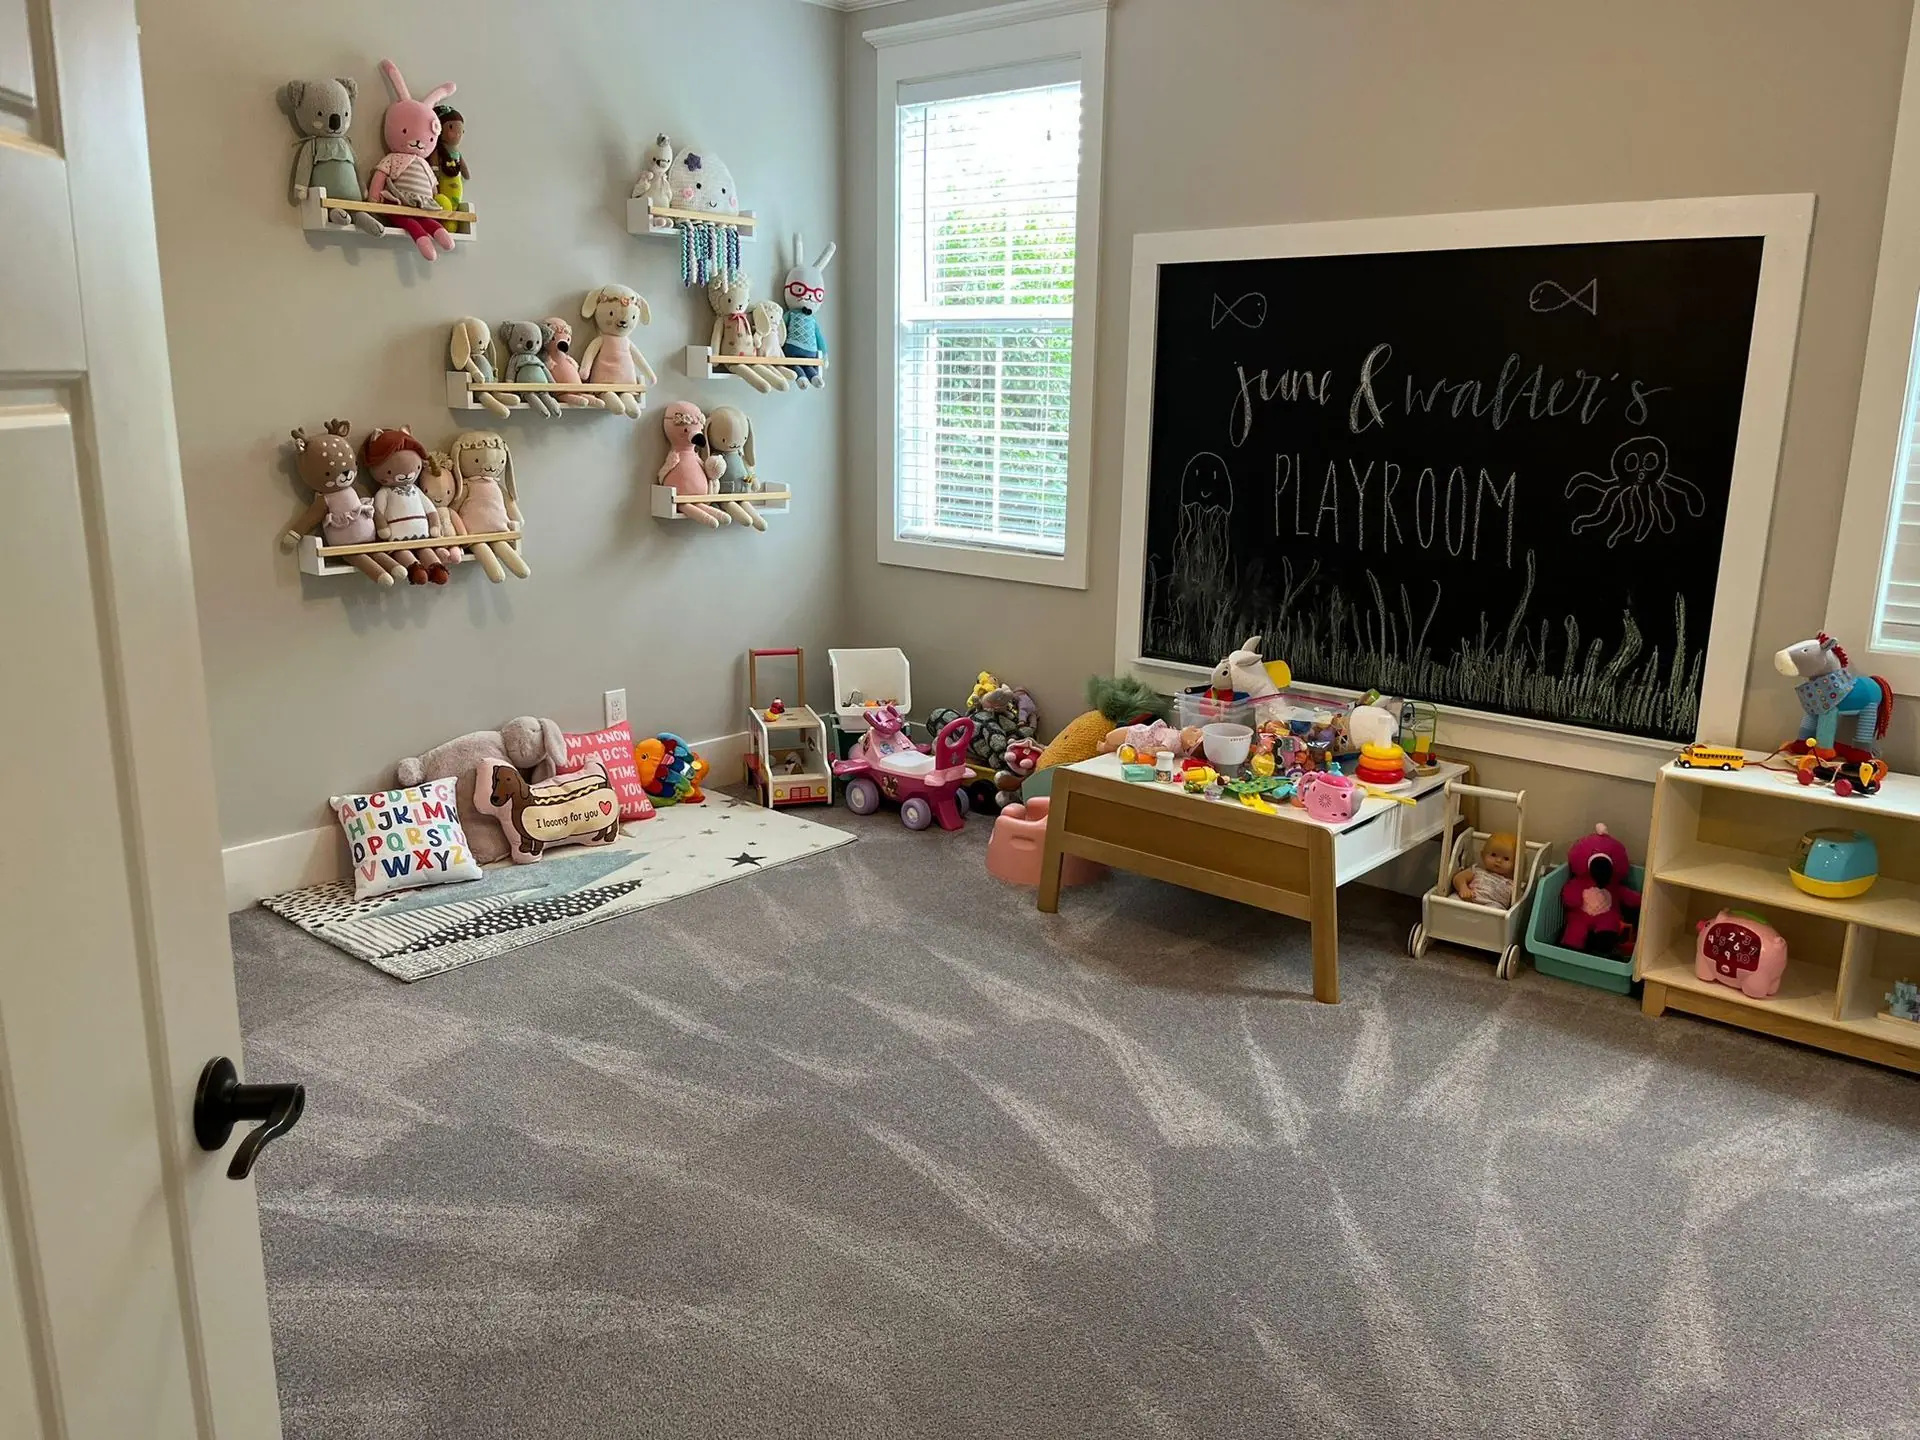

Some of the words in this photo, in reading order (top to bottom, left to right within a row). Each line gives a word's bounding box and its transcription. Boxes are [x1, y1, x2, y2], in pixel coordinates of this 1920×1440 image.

[1230, 361, 1331, 447] june
[1350, 343, 1393, 433] &
[1406, 353, 1673, 430] walter's
[1274, 453, 1517, 568] PLAYROOM
[585, 735, 593, 746] I
[595, 730, 631, 745] KNOW
[609, 766, 637, 780] TIME
[621, 783, 643, 797] YOU
[536, 819, 542, 828] I
[570, 812, 582, 822] for
[584, 810, 599, 821] you
[1708, 935, 1714, 944] 4
[1728, 932, 1736, 941] 2
[1742, 935, 1752, 945] 3
[1733, 942, 1740, 951] 6
[1748, 946, 1758, 955] 7
[1724, 950, 1731, 960] 9
[1736, 952, 1750, 964] 10
